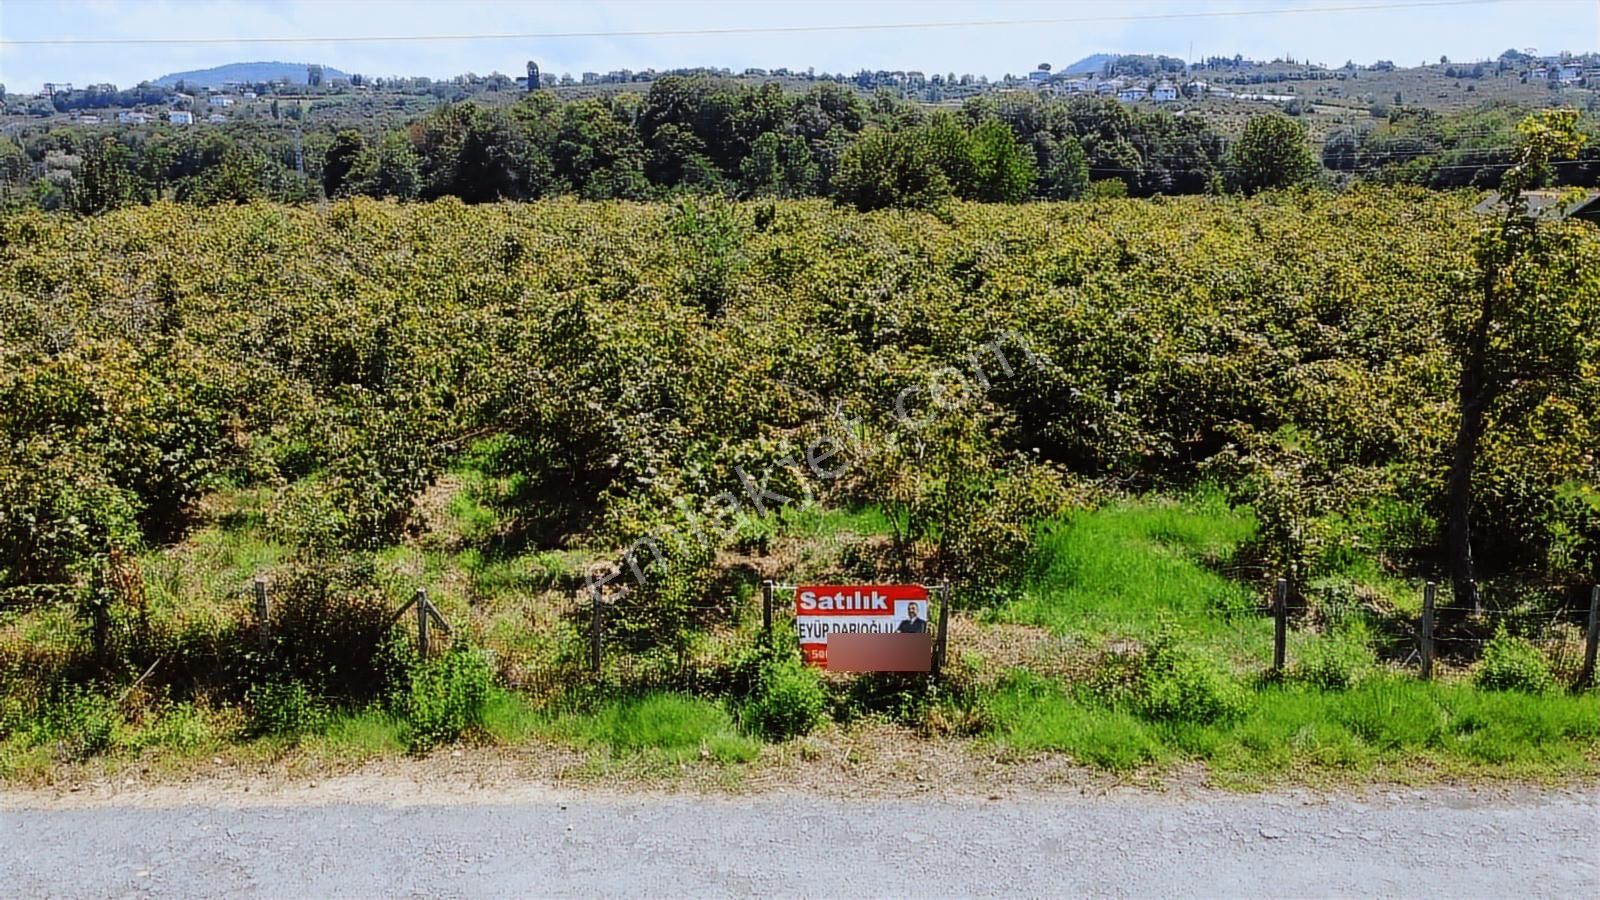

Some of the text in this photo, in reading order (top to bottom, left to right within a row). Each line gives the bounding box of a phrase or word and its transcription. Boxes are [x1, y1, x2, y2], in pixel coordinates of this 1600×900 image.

[800, 591, 888, 610] Satılık
[799, 620, 893, 638] EYÜP DARIOĞLU
